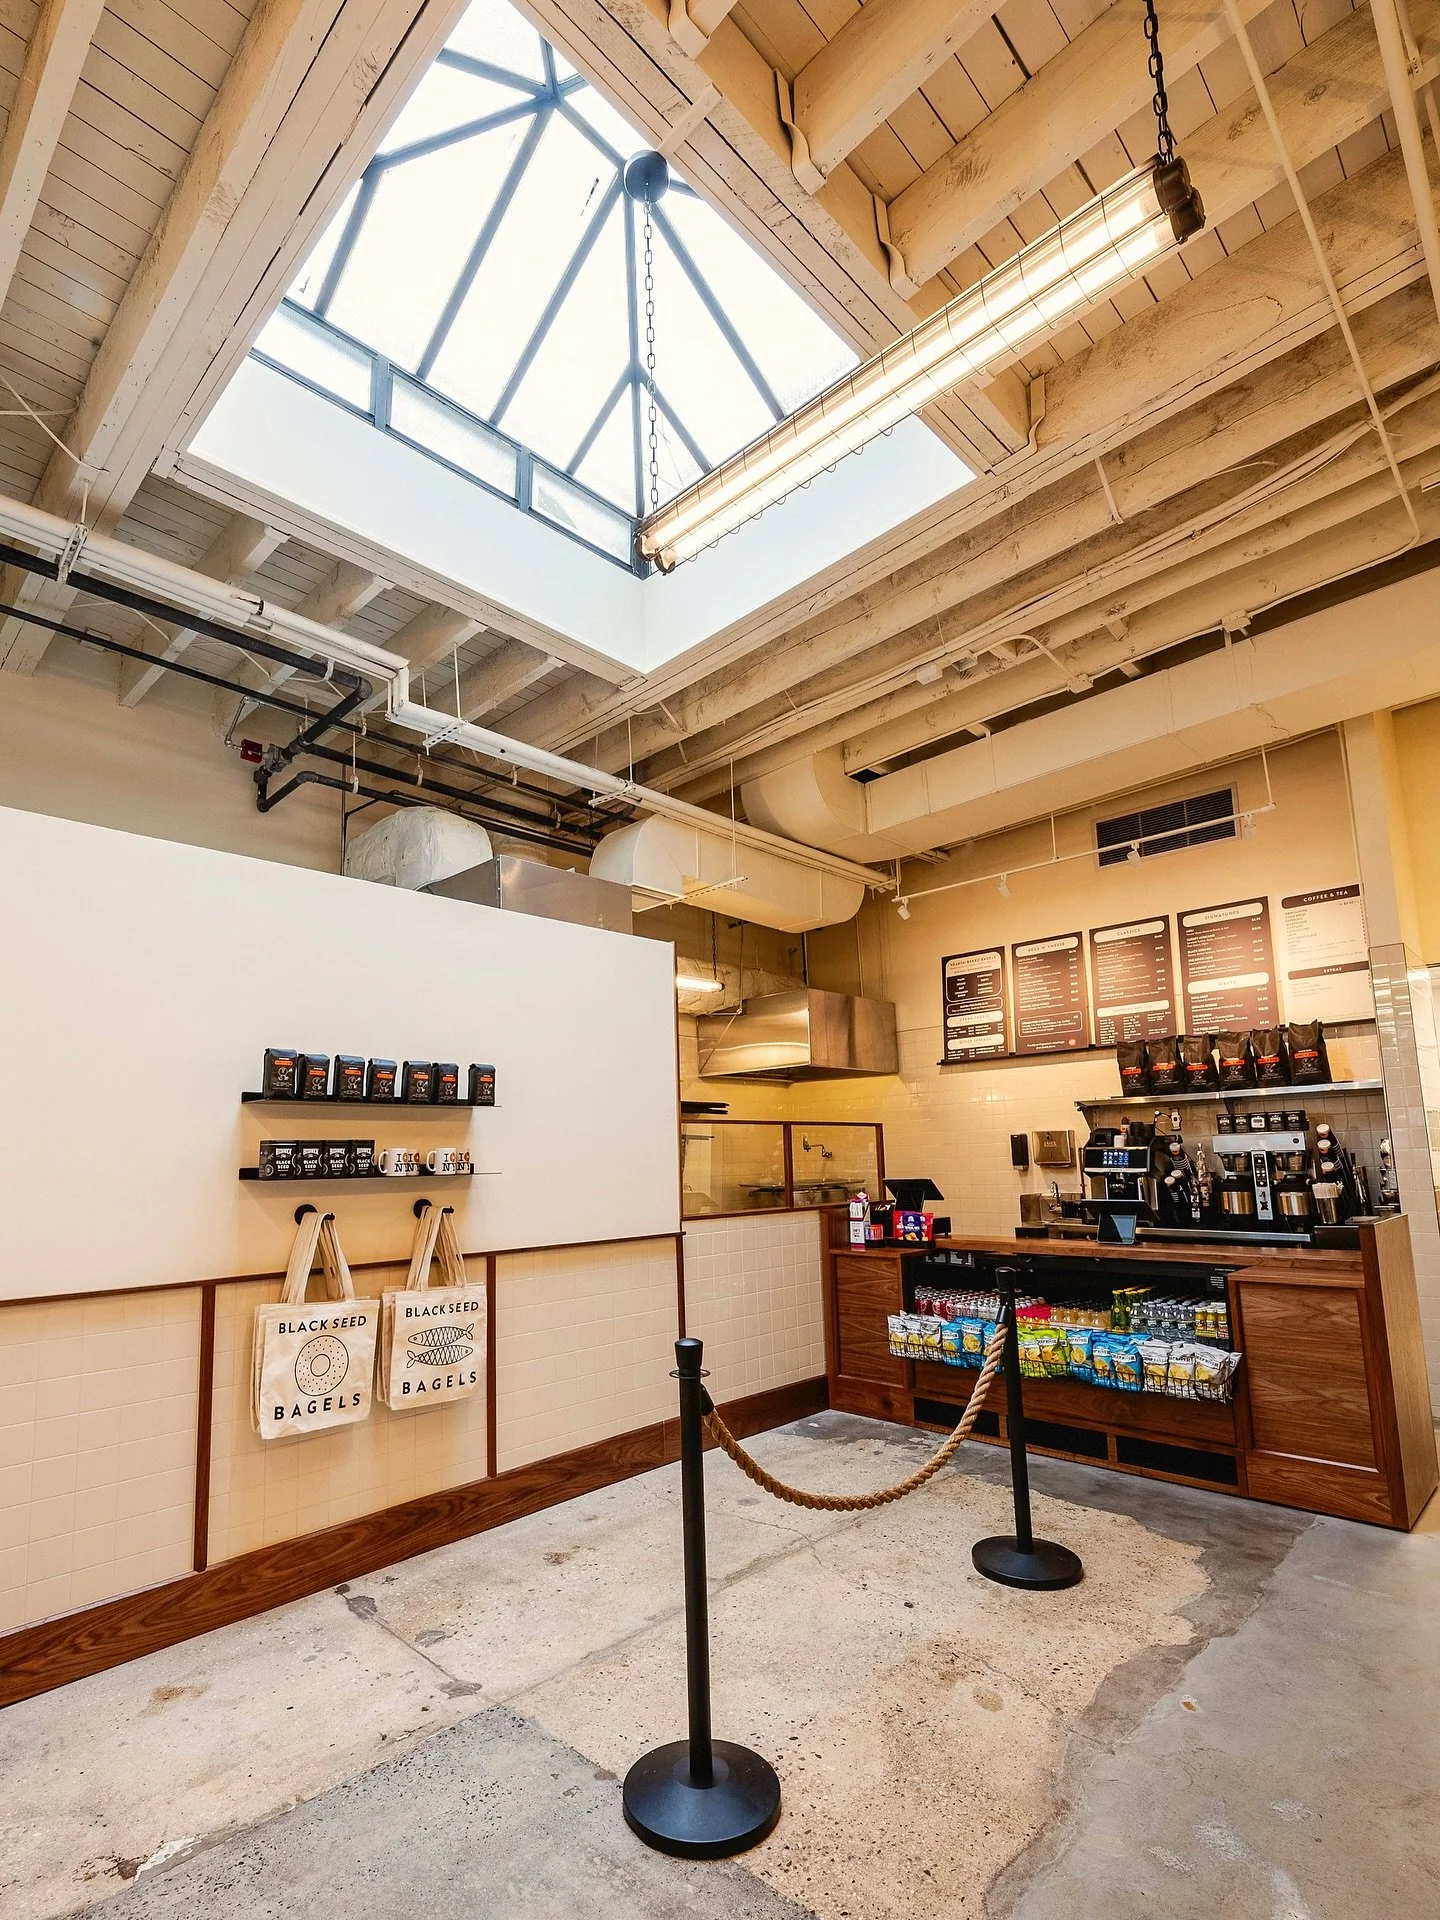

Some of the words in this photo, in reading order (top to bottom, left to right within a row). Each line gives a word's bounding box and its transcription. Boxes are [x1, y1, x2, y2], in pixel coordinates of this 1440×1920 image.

[1303, 894, 1328, 902] COFFEE
[1205, 910, 1240, 920] SIGNATURES
[1117, 928, 1140, 936] CLASSICS
[406, 1304, 445, 1318] BLACK
[448, 1301, 479, 1313] SEED
[278, 1319, 328, 1334] BLACK
[332, 1315, 367, 1329] SEED
[402, 1371, 477, 1395] BAGELS
[273, 1393, 361, 1421] BAGELS
